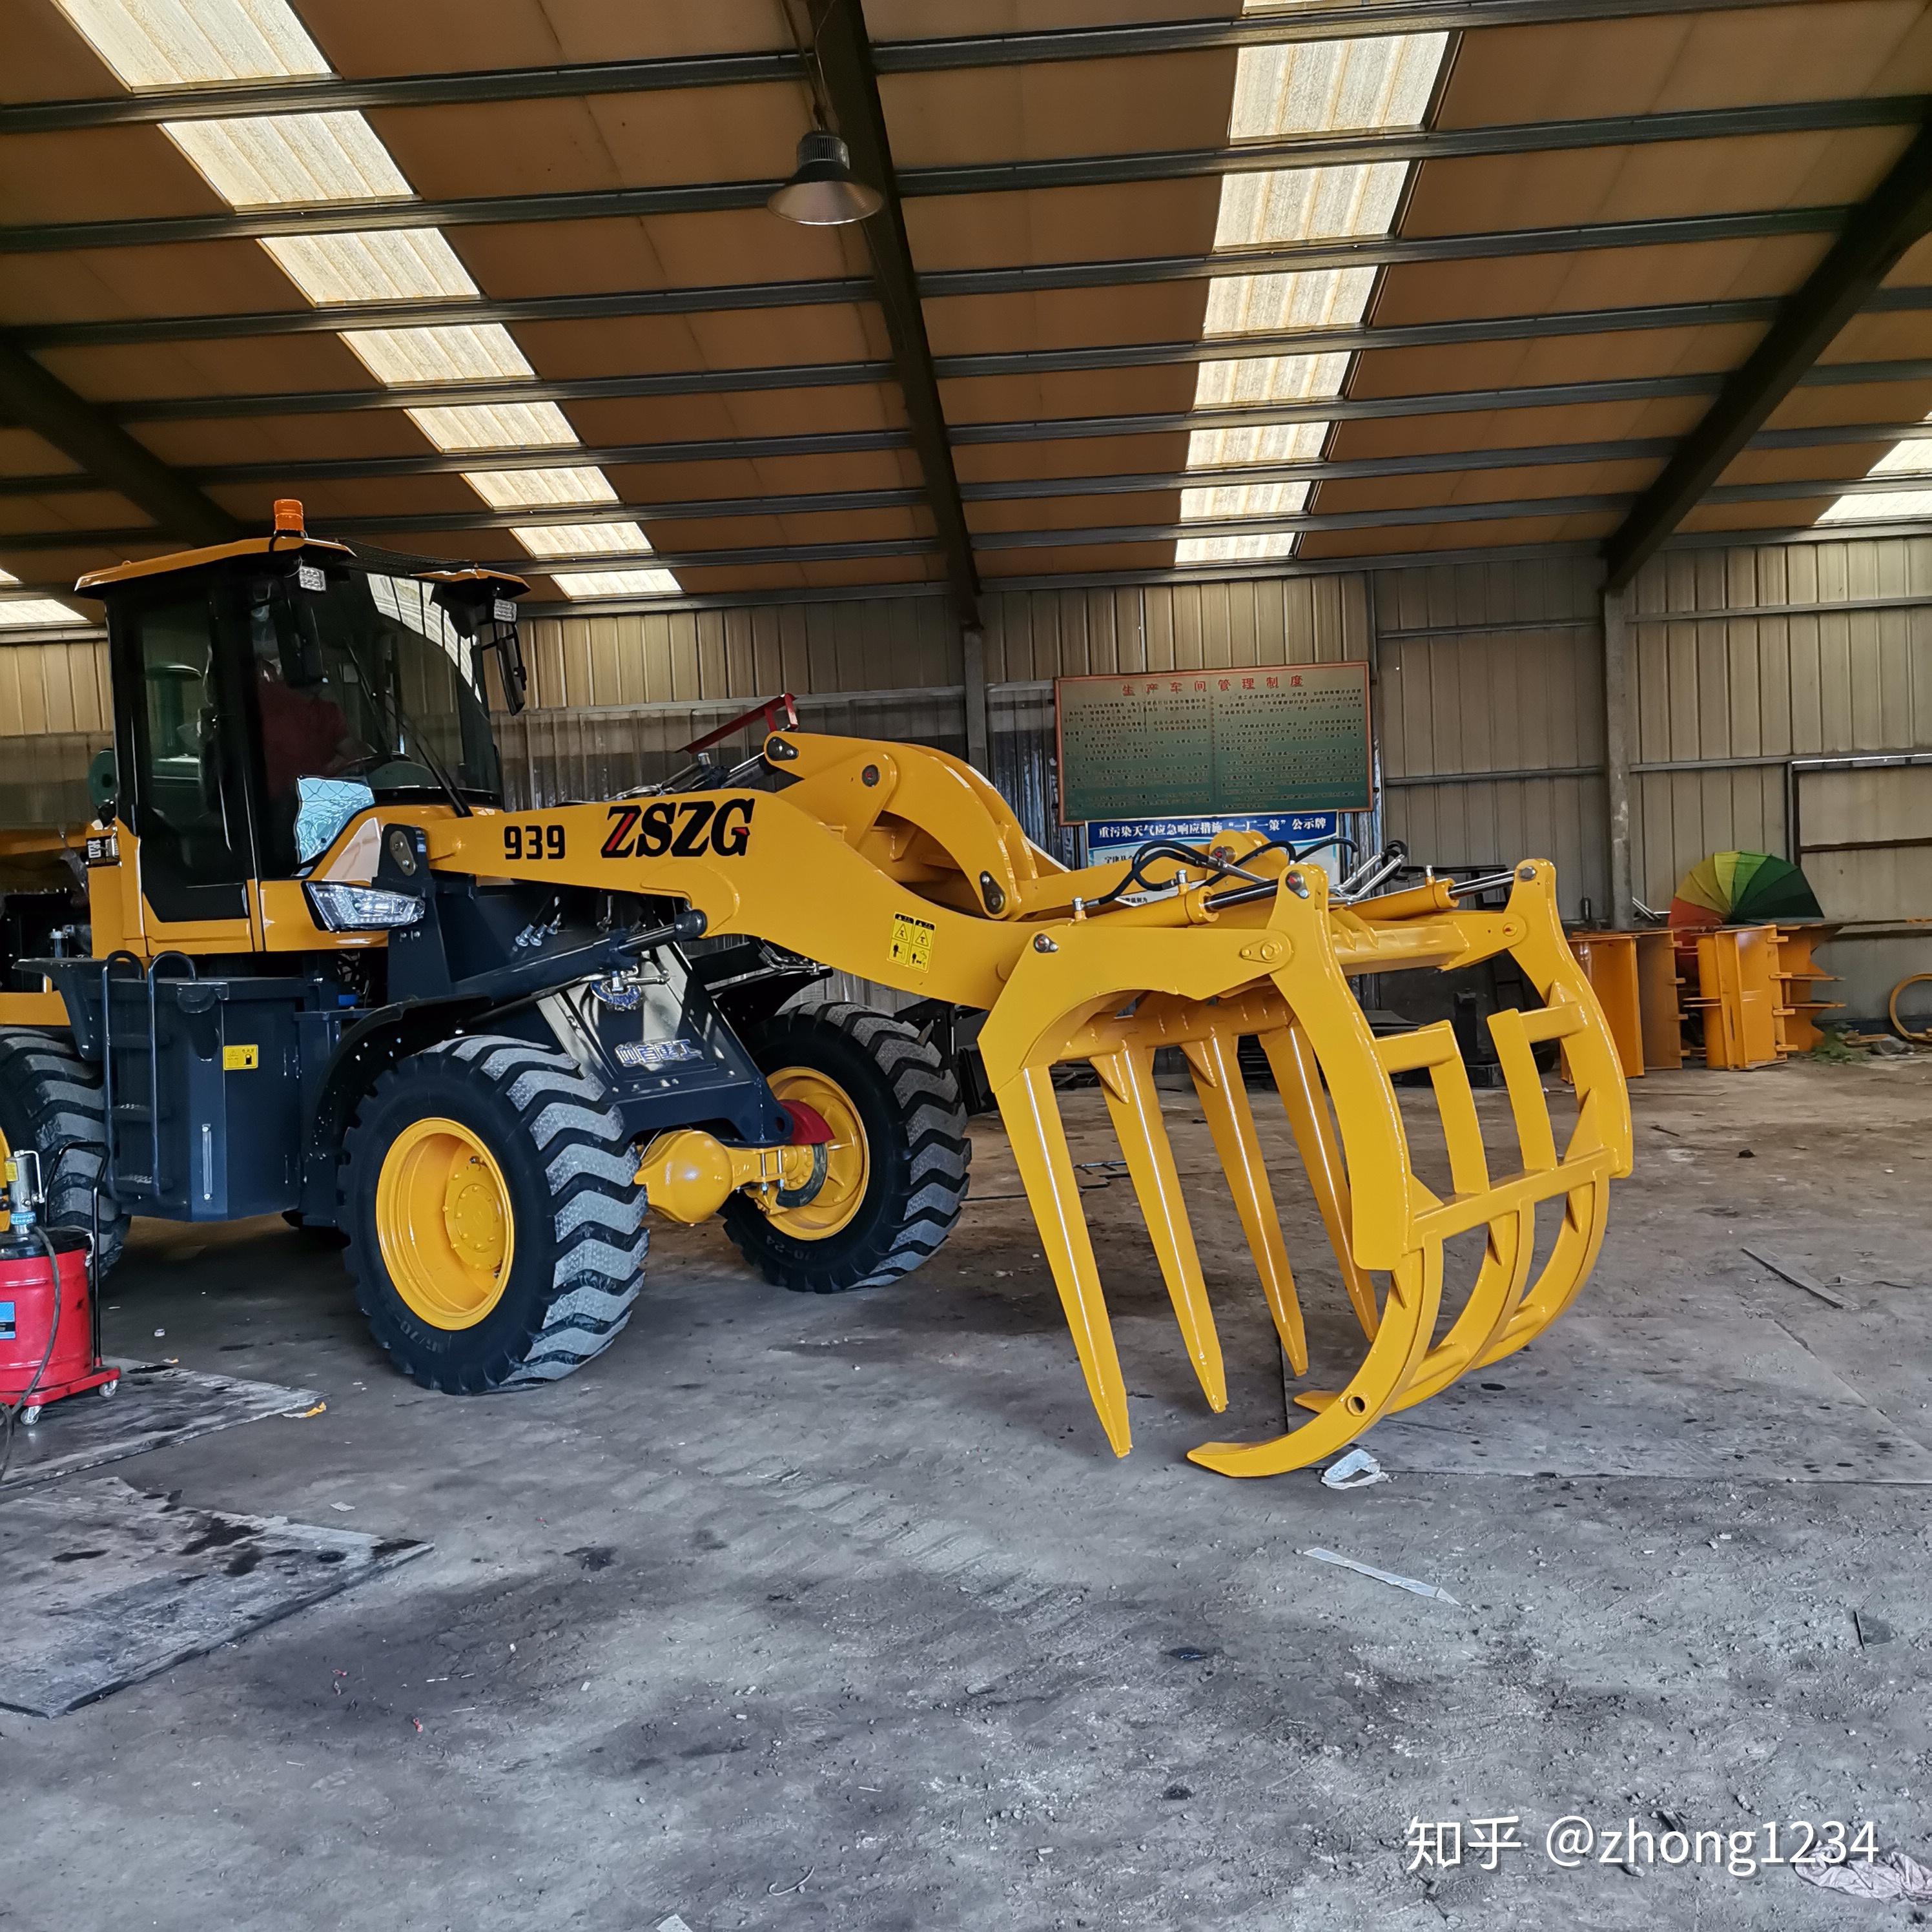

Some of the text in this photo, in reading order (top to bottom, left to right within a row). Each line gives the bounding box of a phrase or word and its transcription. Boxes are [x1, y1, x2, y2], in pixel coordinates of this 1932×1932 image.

[1122, 675, 1304, 696] 生产车间管理制度
[504, 797, 755, 860] 939 ZSZG
